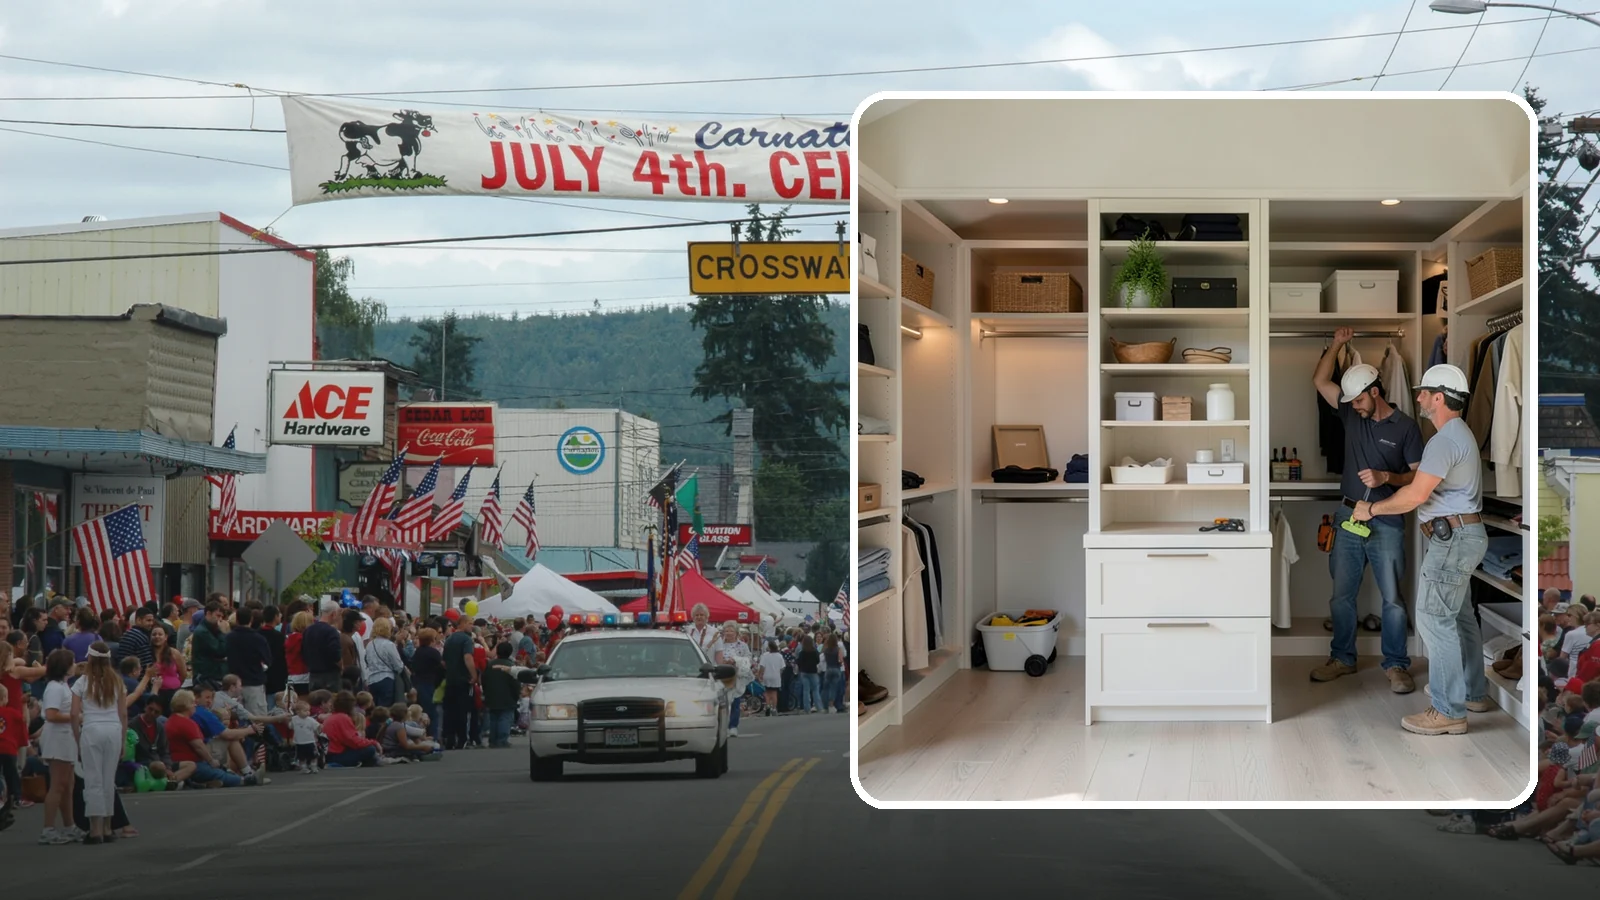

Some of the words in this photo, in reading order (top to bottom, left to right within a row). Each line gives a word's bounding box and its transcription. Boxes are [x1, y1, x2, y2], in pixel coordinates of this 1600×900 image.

[481, 141, 604, 193] JULY
[632, 150, 746, 198] 4th.
[697, 254, 851, 280] CROSSWA
[282, 380, 373, 420] ACE
[405, 409, 453, 422] CEDAR
[461, 409, 485, 422] LOG
[283, 421, 370, 436] Hardware
[416, 427, 477, 447] Coca-Cola
[353, 466, 383, 480] Simpl
[95, 484, 124, 495] Vincent
[126, 485, 136, 495] de
[137, 485, 155, 496] Paul
[688, 526, 741, 535] CRNATION
[699, 535, 730, 543] GLASS
